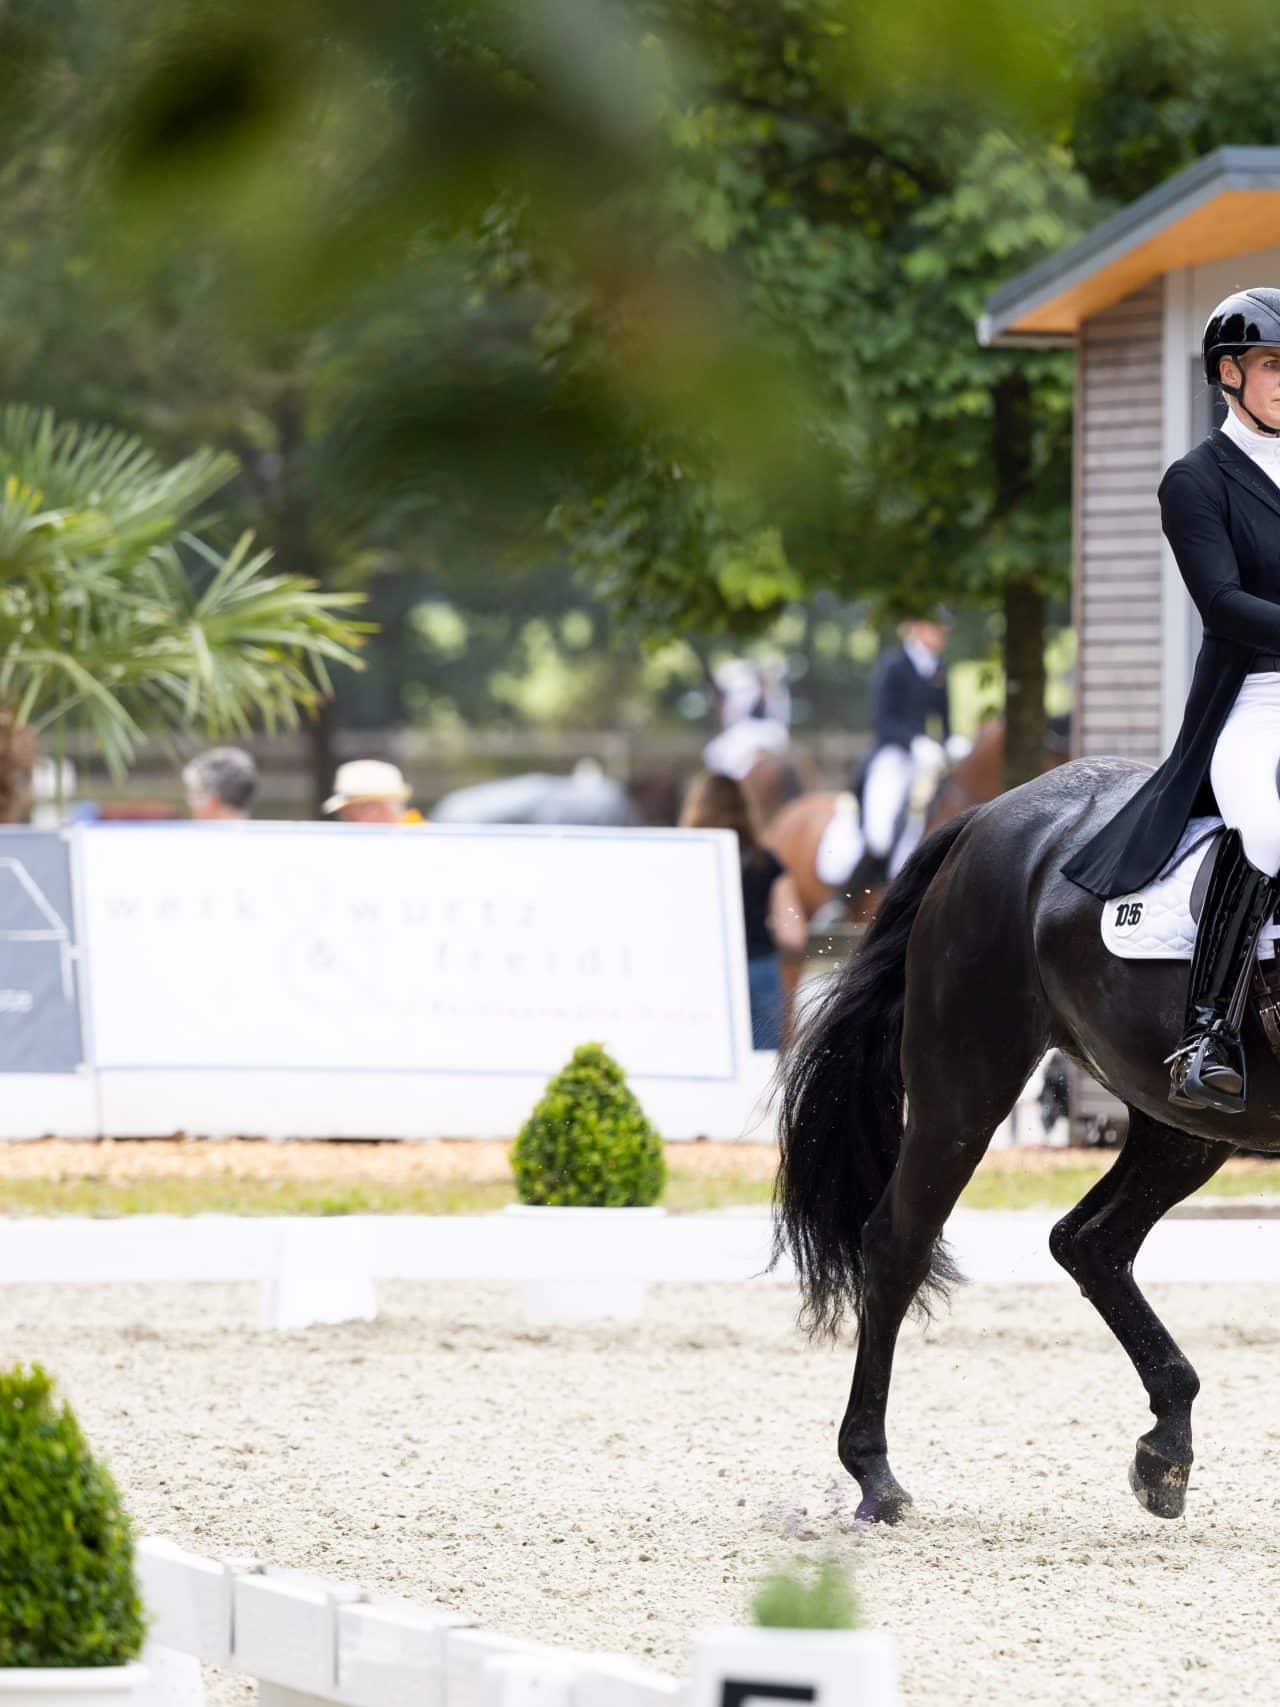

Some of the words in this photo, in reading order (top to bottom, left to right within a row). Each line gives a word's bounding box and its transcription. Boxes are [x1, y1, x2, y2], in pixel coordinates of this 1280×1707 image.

[102, 888, 257, 920] werk
[1115, 902, 1143, 927] 1056
[305, 936, 338, 970] &
